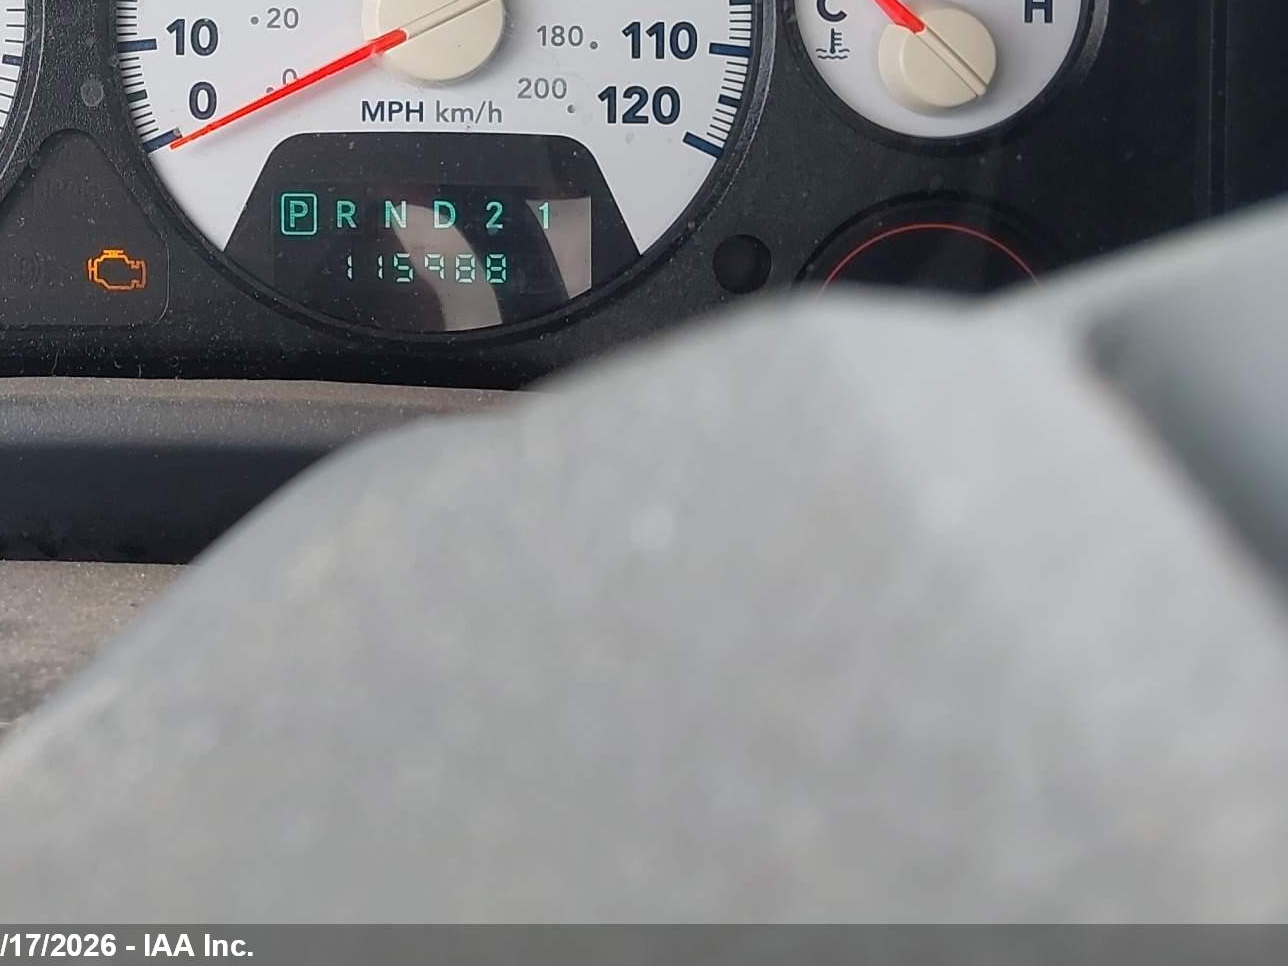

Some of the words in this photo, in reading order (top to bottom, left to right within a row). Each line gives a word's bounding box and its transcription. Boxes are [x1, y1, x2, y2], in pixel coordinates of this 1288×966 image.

[267, 8, 298, 28] 20
[167, 19, 218, 56] 10
[537, 26, 583, 46] 180
[622, 22, 697, 60] 110
[188, 82, 218, 121] 0
[518, 78, 567, 99] 200
[362, 101, 423, 122] MPH
[436, 100, 502, 124] km/h
[598, 86, 680, 124] 120
[290, 201, 308, 227] P
[337, 201, 356, 228] R
[384, 201, 407, 229] N
[433, 201, 456, 229] D
[486, 202, 503, 228] 2
[537, 202, 551, 229] 1
[346, 253, 506, 283] 115988
